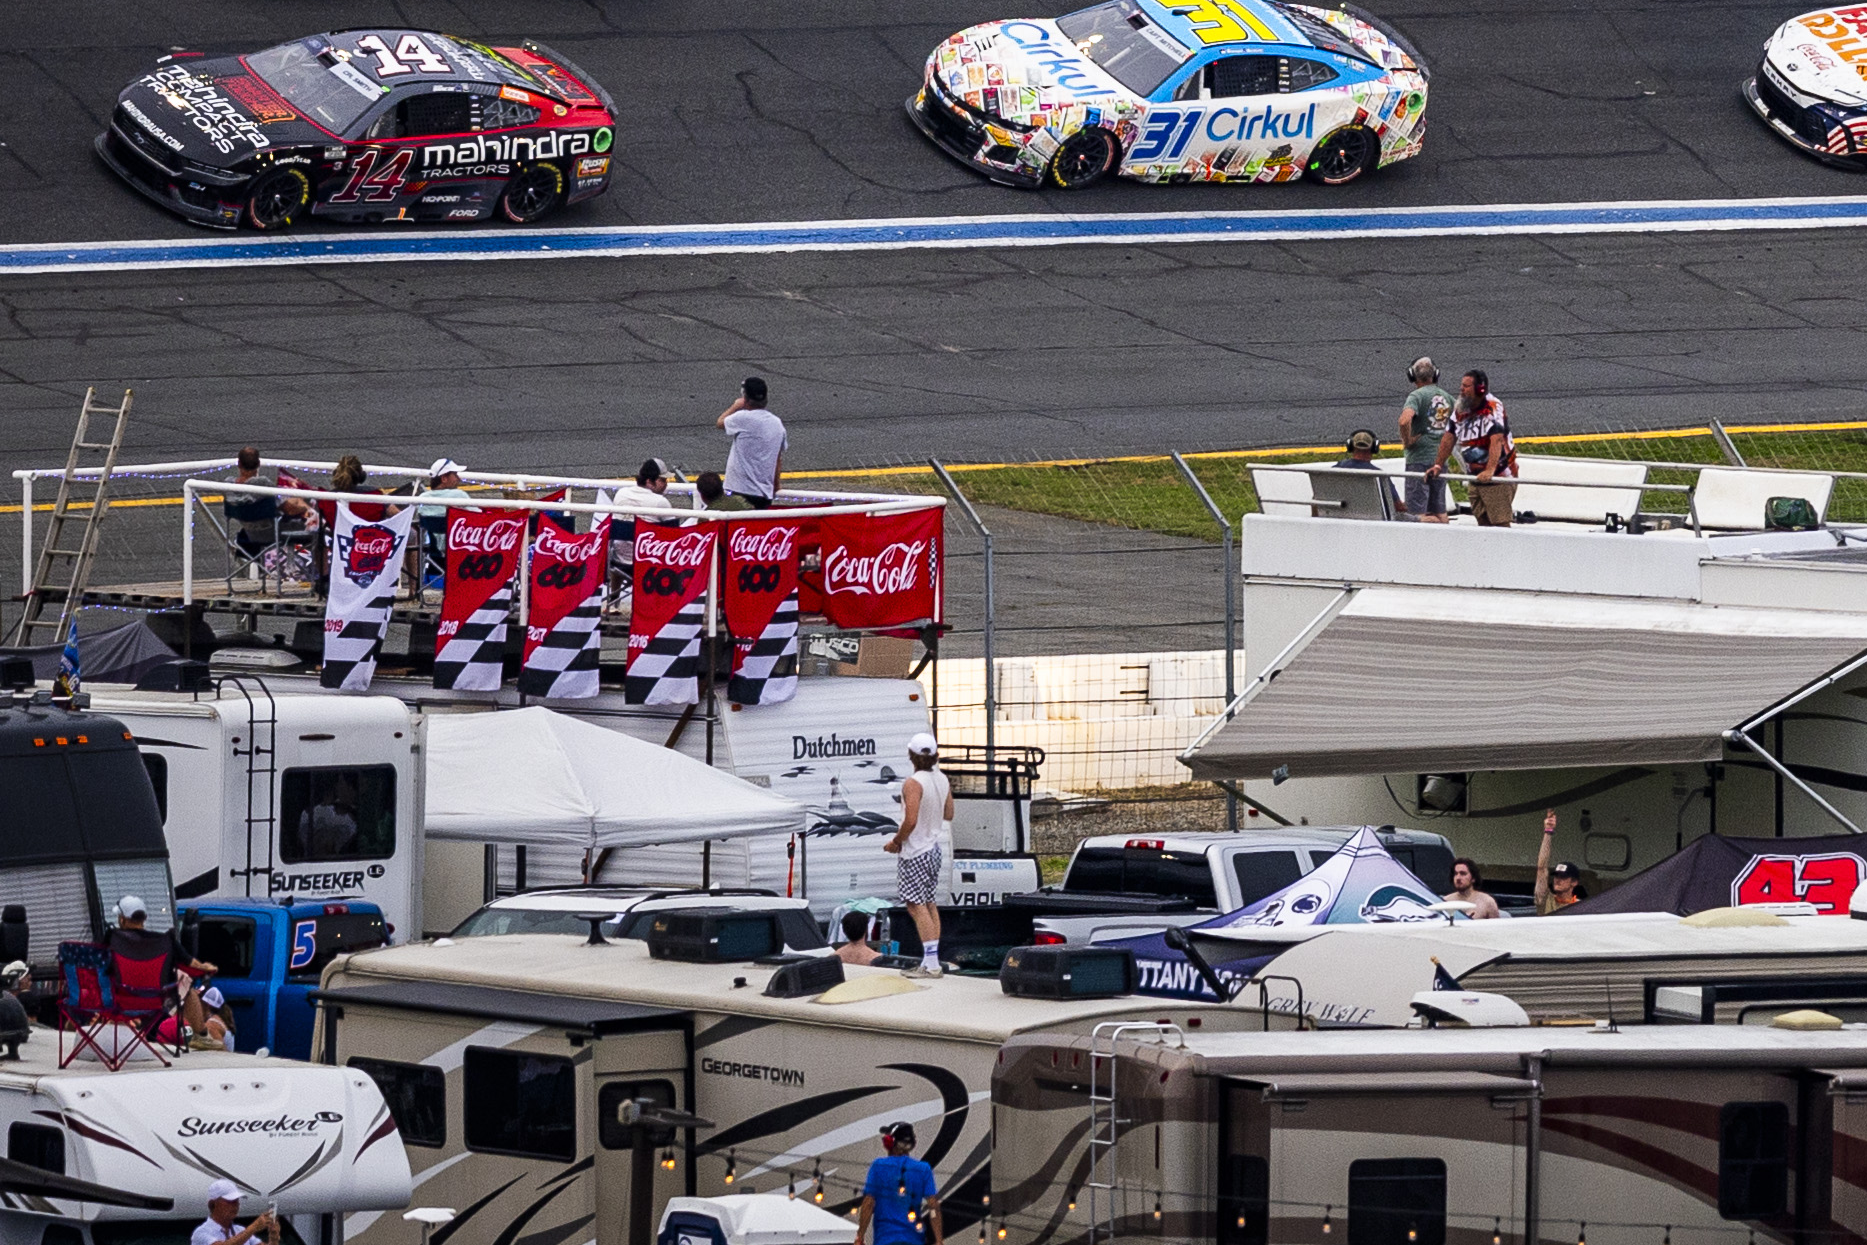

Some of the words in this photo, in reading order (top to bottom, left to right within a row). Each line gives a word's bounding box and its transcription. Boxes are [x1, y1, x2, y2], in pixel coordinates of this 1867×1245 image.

[356, 34, 453, 80] 14
[1000, 22, 1118, 98] Cirkul
[1127, 108, 1203, 162] 31
[1206, 103, 1316, 143] Cirkul
[422, 130, 590, 167] mahindra
[328, 147, 417, 204] 14
[421, 164, 510, 180] TRACTORS
[448, 208, 479, 218] FORD
[457, 552, 505, 581] 600
[737, 563, 782, 594] 600
[823, 539, 930, 596] Coca-Cola
[324, 618, 344, 633] 2019
[792, 733, 877, 760] Dutchmen
[290, 920, 317, 969] 5
[702, 1057, 805, 1085] GEORGETOWN
[177, 1112, 319, 1138] Sunseeker
